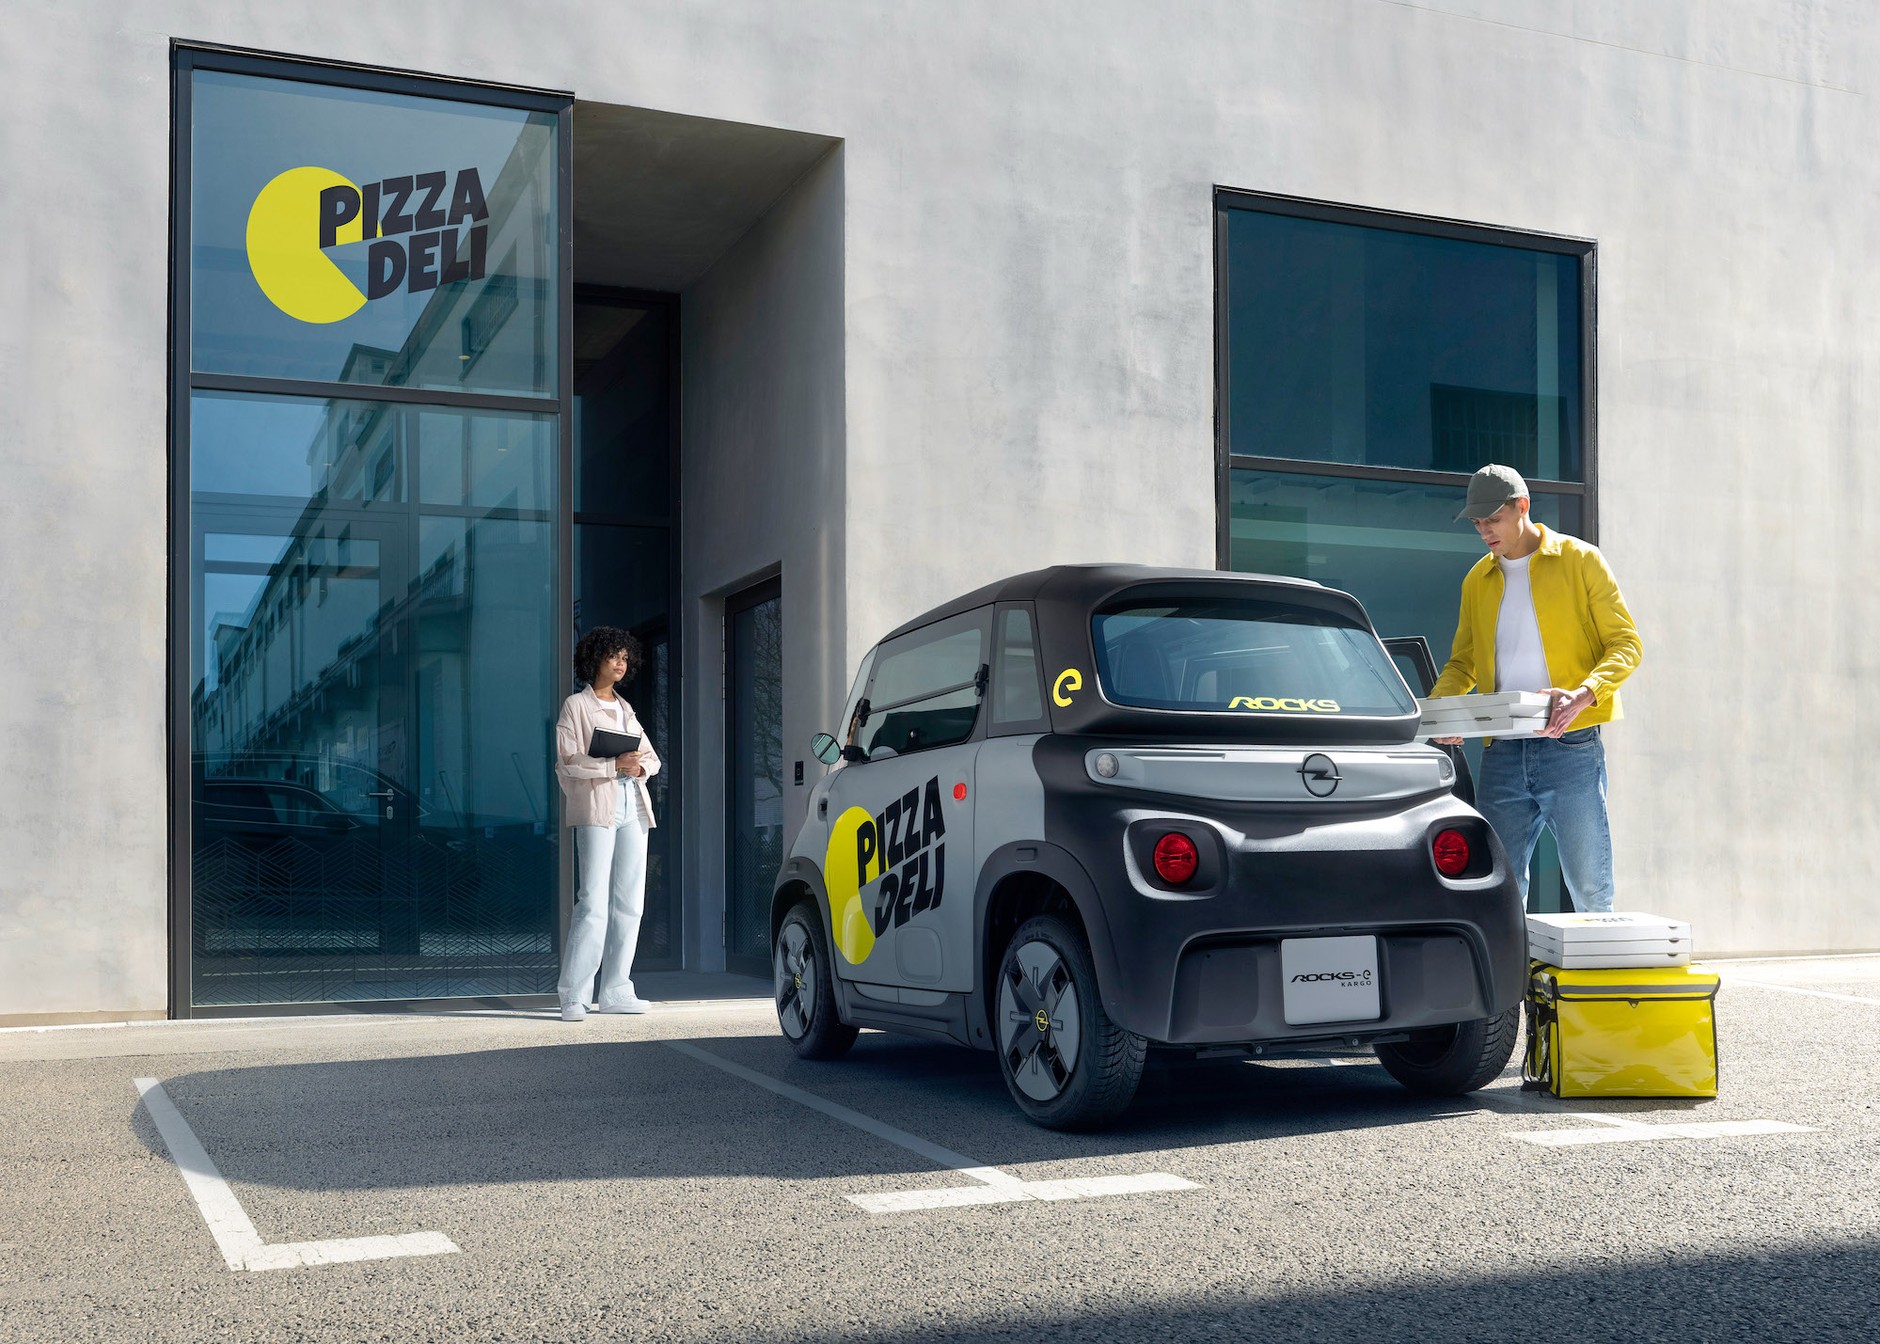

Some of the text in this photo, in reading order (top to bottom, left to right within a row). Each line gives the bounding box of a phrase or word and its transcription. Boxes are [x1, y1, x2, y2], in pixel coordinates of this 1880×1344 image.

[320, 167, 489, 249] PIZZA
[367, 224, 488, 301] DELI
[1228, 696, 1341, 713] ROCKS
[856, 775, 946, 889] PIZZA
[874, 841, 945, 939] DELI
[1341, 980, 1372, 988] KARGO
